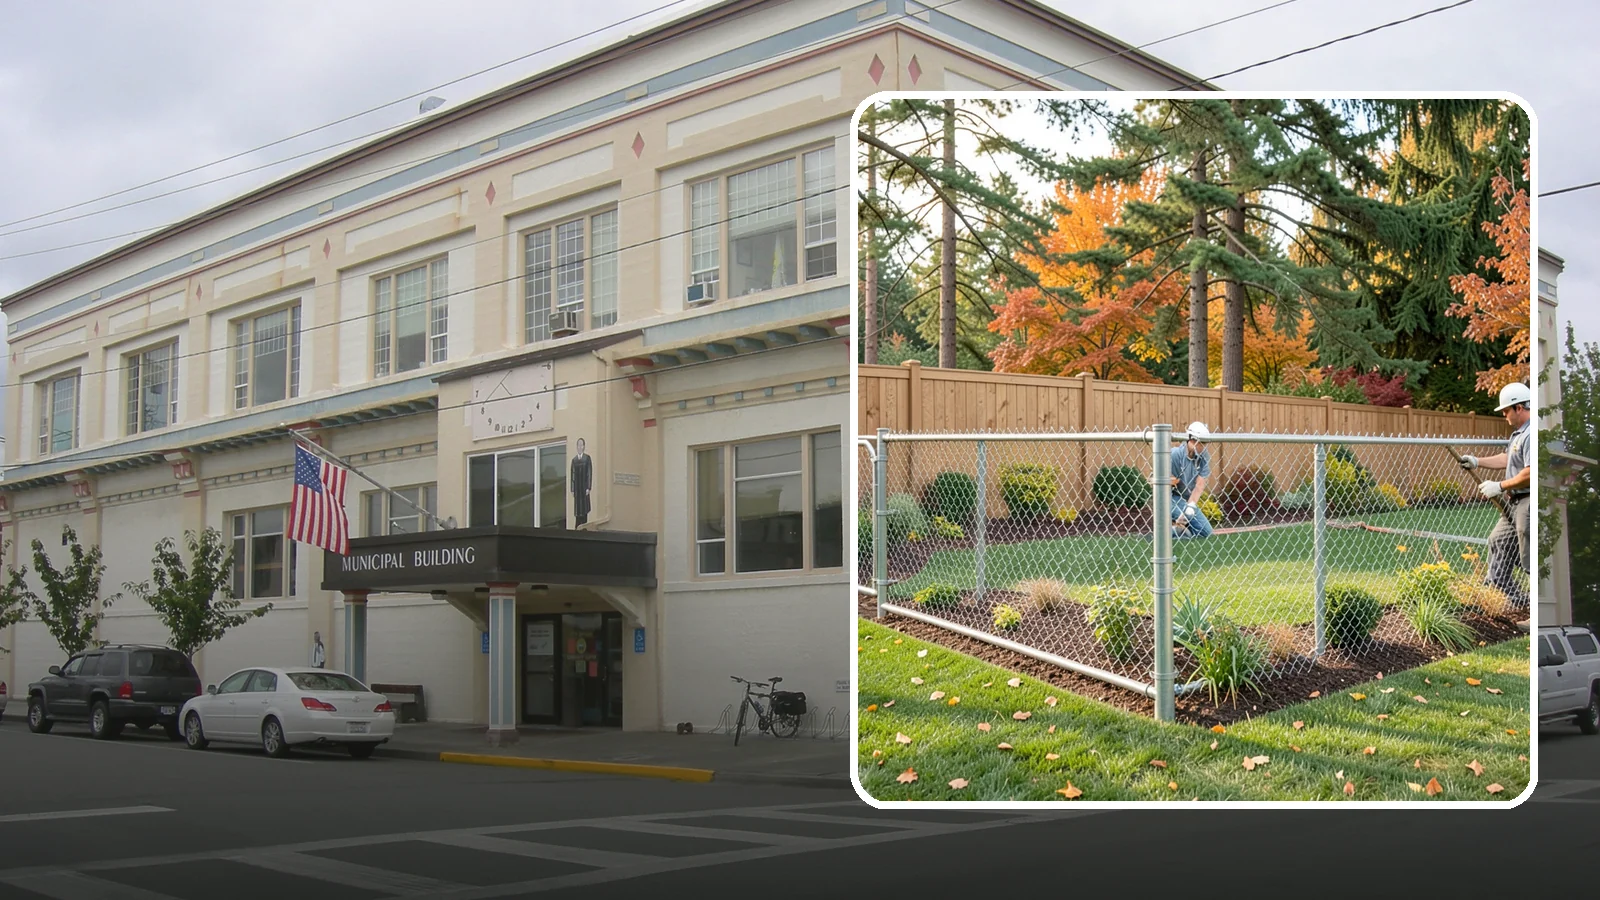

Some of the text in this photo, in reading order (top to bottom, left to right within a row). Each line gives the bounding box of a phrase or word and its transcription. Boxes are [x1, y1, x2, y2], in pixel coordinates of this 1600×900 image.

[547, 362, 551, 370] 6
[475, 390, 479, 398] 7
[536, 402, 540, 410] 4
[481, 407, 485, 415] 8
[488, 418, 492, 426] 9
[529, 414, 533, 422] 3
[521, 420, 526, 428] 2
[501, 425, 506, 433] 11
[508, 425, 513, 433] 12
[342, 546, 475, 571] MUNICIPAL BUILDING
